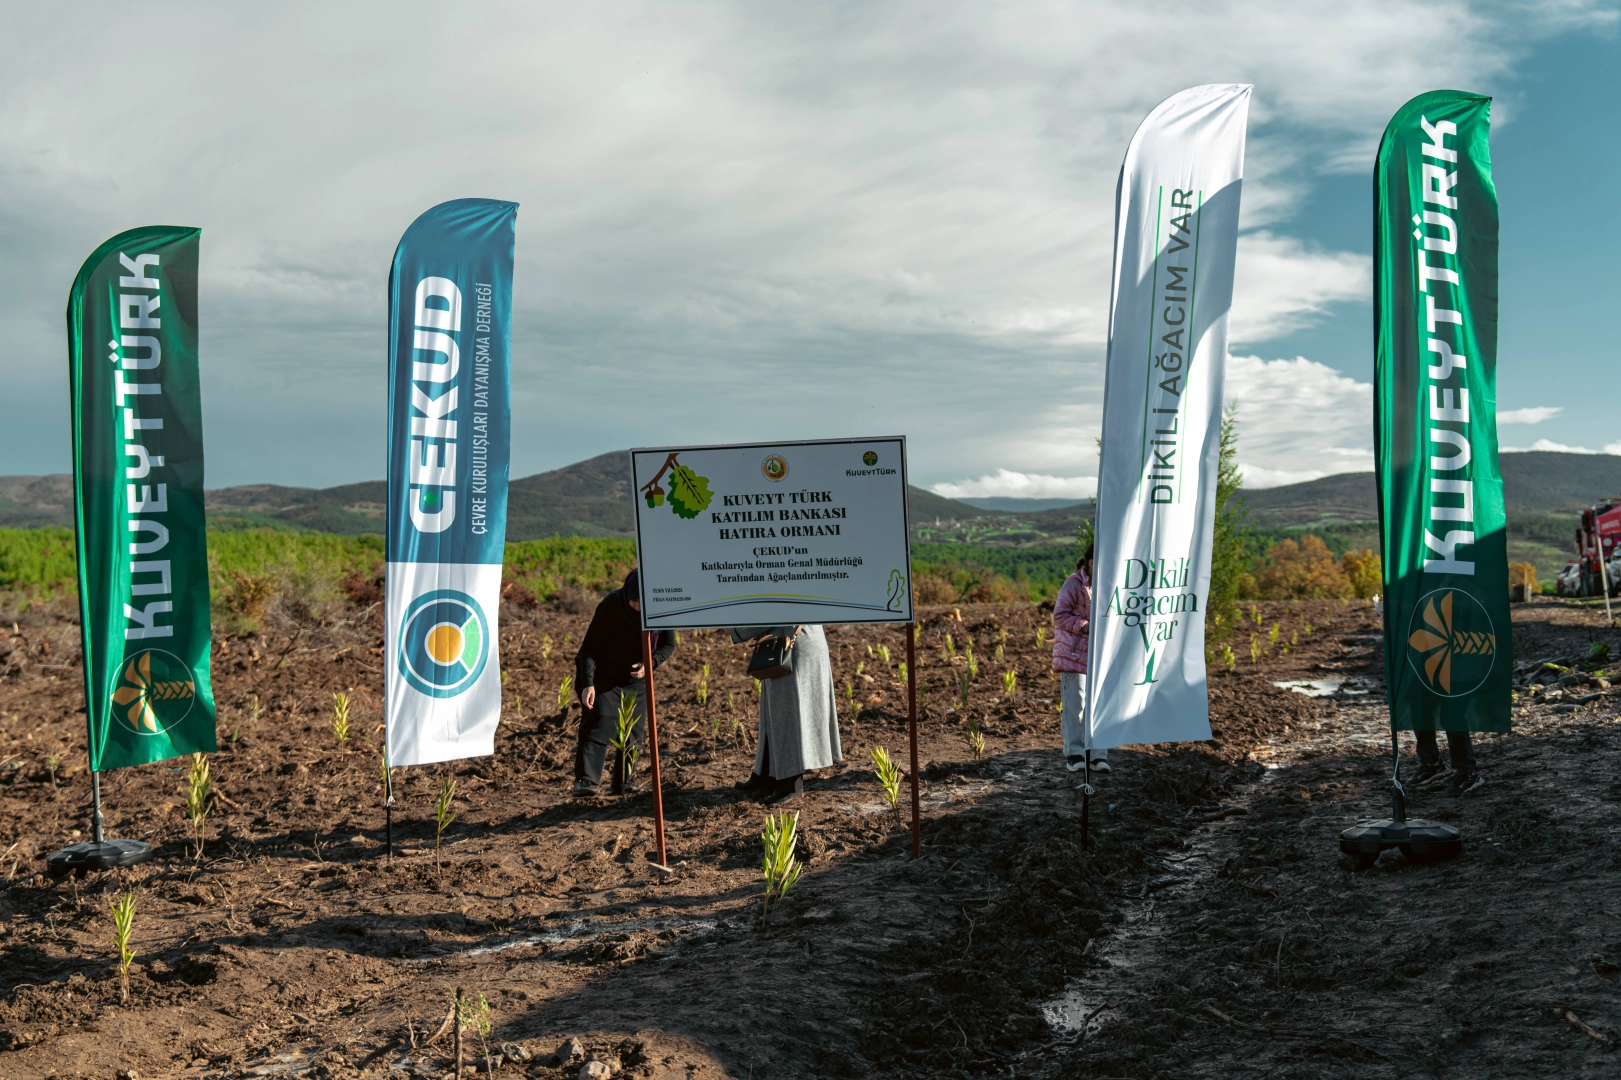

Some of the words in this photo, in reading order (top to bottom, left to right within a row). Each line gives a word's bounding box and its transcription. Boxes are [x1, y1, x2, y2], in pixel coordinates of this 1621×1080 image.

[1167, 188, 1193, 254] VAR
[474, 282, 492, 333] DERNEĞİ
[1154, 265, 1188, 397] AĞACIM
[1413, 114, 1477, 577] KUVEYTTÜRK
[473, 336, 492, 408] DAYANIŞMA
[108, 251, 174, 641] KUVEYTTÜRK
[472, 412, 490, 494] KURULUŞLARI
[1147, 407, 1178, 504] DİKİLİ
[471, 497, 488, 535] ÇEVRE
[711, 508, 775, 524] KATILIM
[779, 507, 847, 521] BANKASI
[723, 492, 785, 507] KUVEYT
[789, 489, 833, 504] TÜRK
[719, 526, 776, 540] HATIRA
[780, 524, 841, 538] ORMANI
[701, 561, 754, 572] Katkılarıyla
[755, 559, 786, 570] Orman
[787, 558, 813, 568] Genal
[815, 556, 863, 568] Müdürlüğü
[716, 572, 765, 583] Tarafından
[767, 570, 850, 583] Ağaçlandırılmıştır.
[1122, 557, 1191, 590] Dikili
[1102, 586, 1199, 627] Ağacım
[1138, 619, 1178, 655] Var
